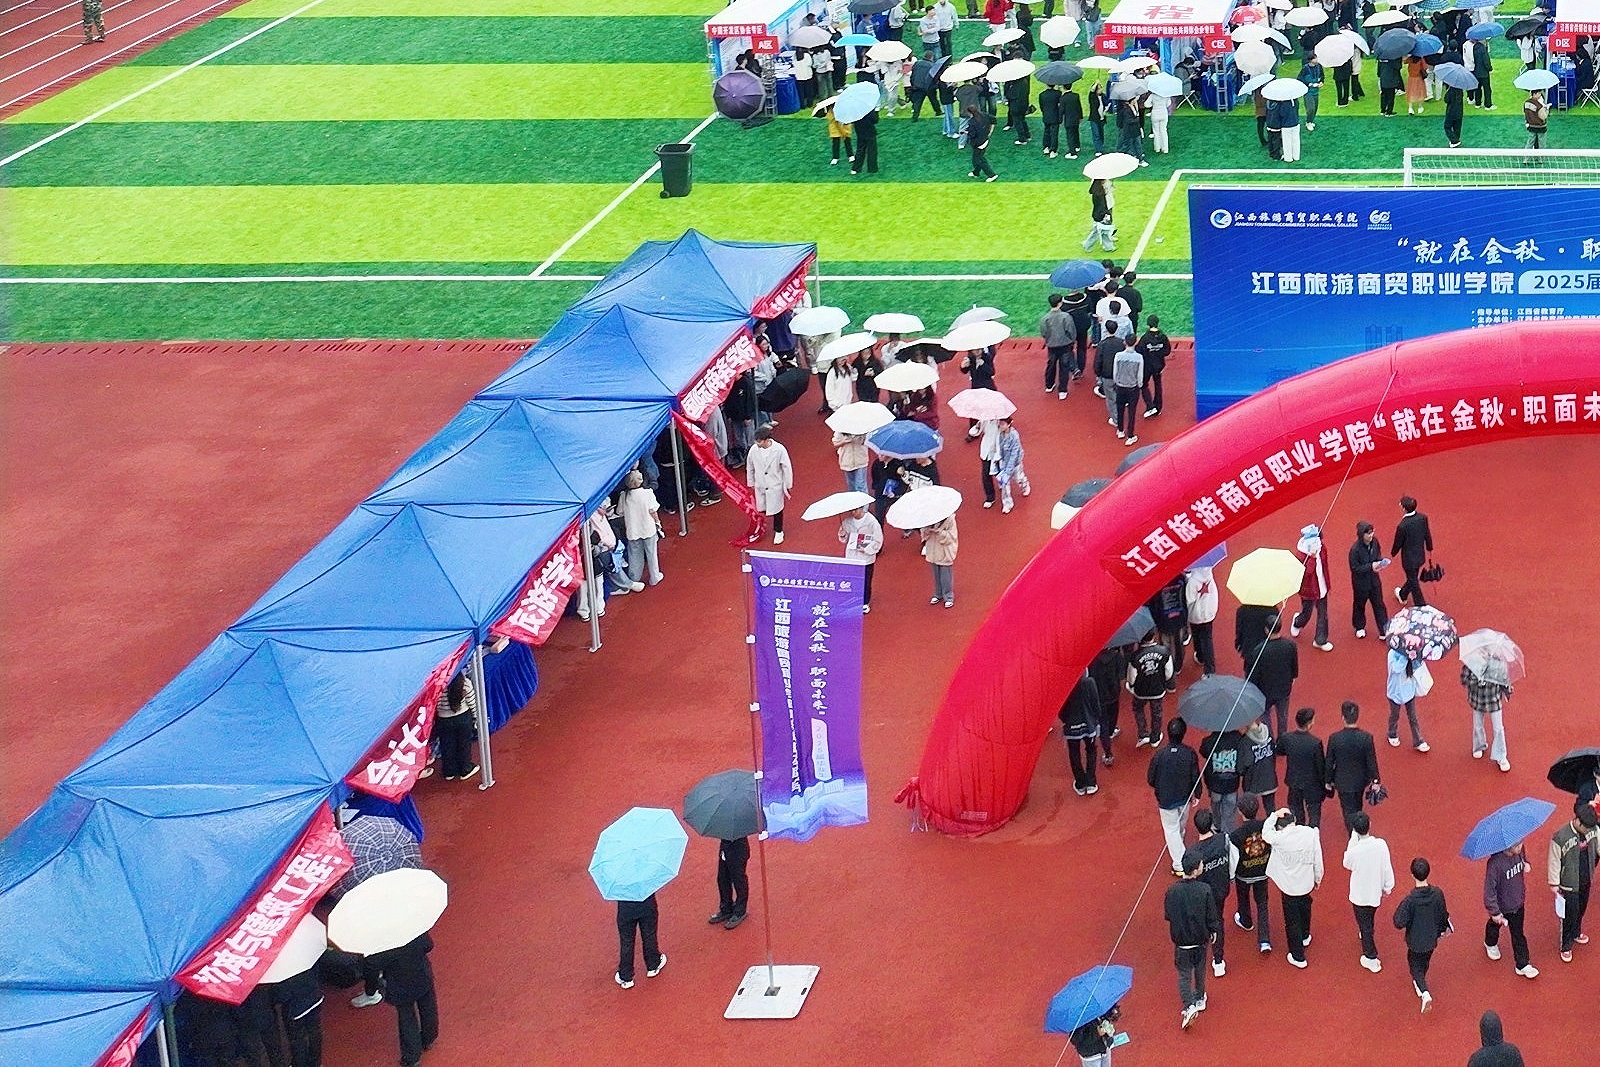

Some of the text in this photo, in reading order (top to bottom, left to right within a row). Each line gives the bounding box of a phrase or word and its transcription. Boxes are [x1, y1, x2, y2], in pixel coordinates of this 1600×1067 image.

[758, 41, 773, 50] A区
[1103, 39, 1118, 49] B区
[1211, 39, 1226, 49] C区
[1556, 38, 1570, 48] D区
[1251, 271, 1515, 295] 江西旅游商贸职业学院
